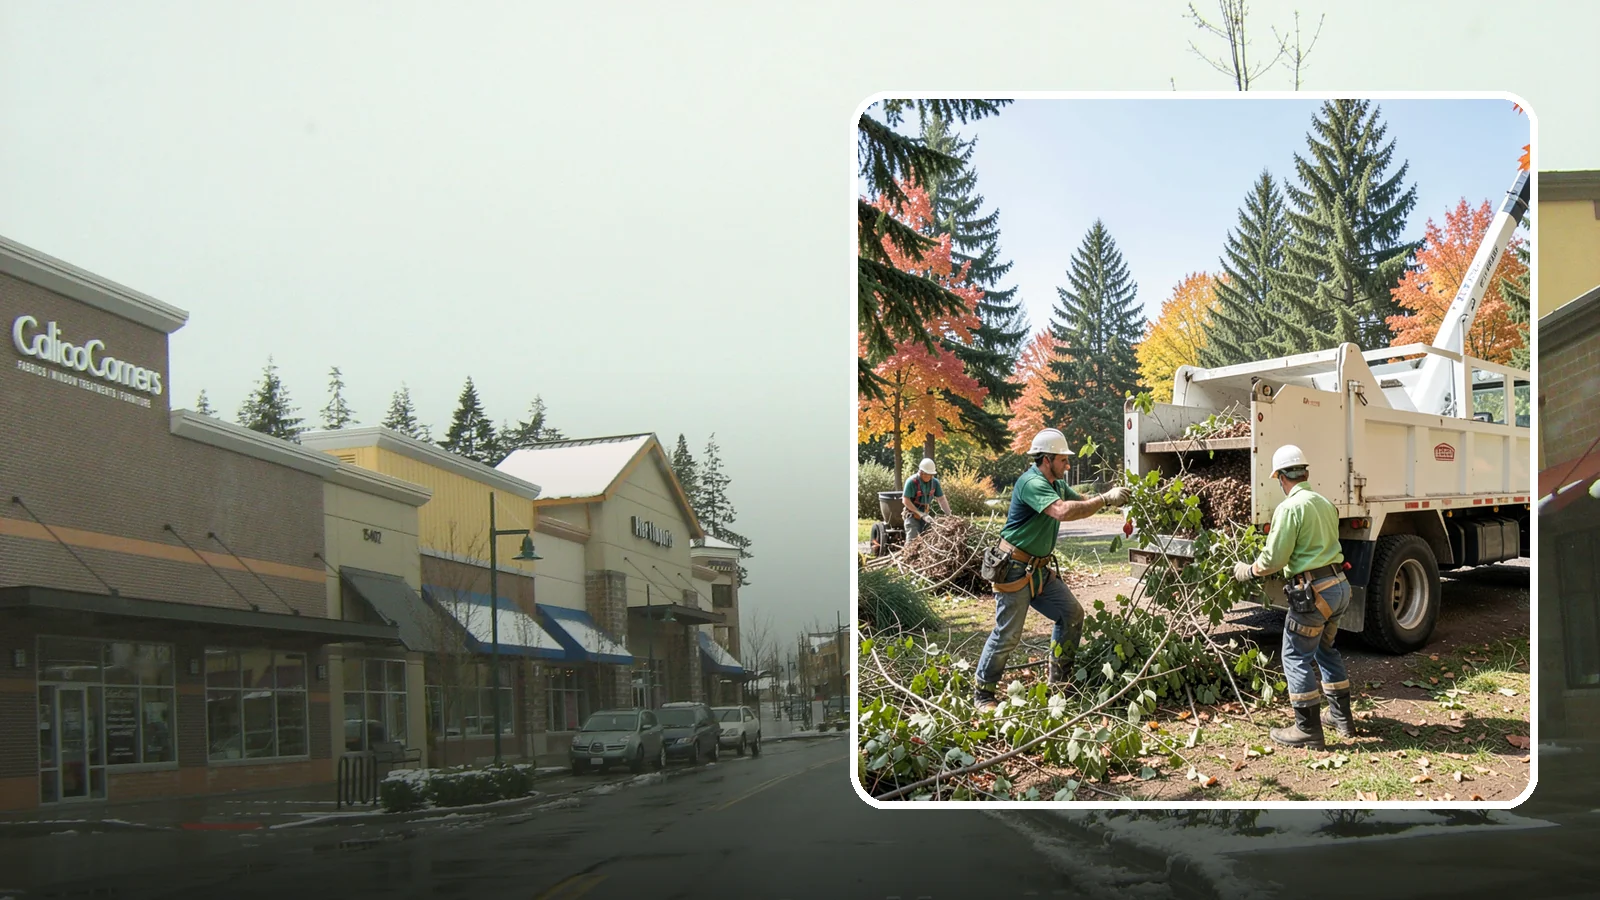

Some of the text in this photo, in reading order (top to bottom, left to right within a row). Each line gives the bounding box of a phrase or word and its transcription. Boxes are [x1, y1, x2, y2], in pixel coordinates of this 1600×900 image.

[17, 360, 151, 408] FABRICS WINDOW TREATMENTS FURNITURE
